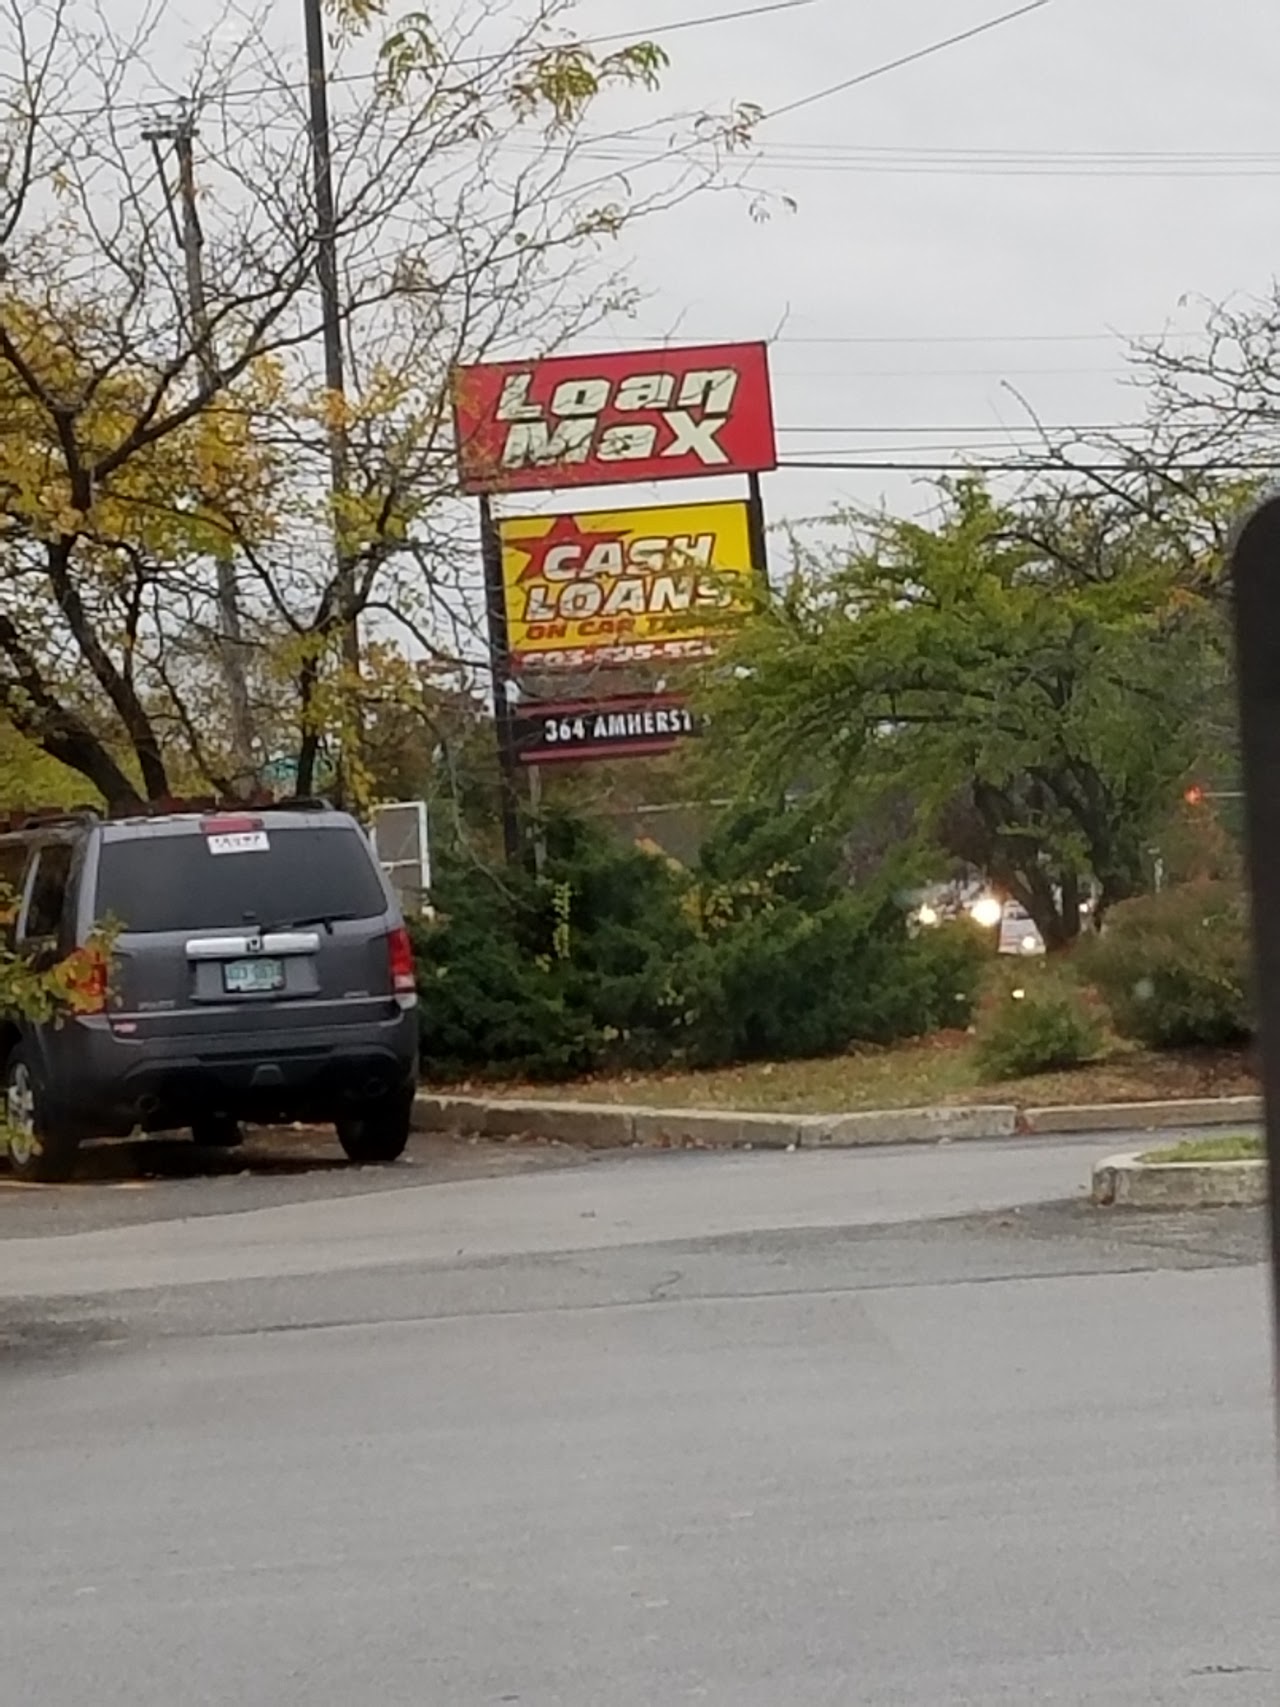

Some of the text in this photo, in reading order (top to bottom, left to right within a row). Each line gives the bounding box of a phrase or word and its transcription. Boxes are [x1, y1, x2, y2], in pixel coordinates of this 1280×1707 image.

[496, 368, 738, 420] Loan
[543, 535, 714, 582] CASH
[525, 573, 734, 622] LOANS
[526, 622, 568, 641] ON
[577, 617, 636, 637] CAR
[545, 718, 586, 742] 364
[593, 708, 693, 738] AMHERST
